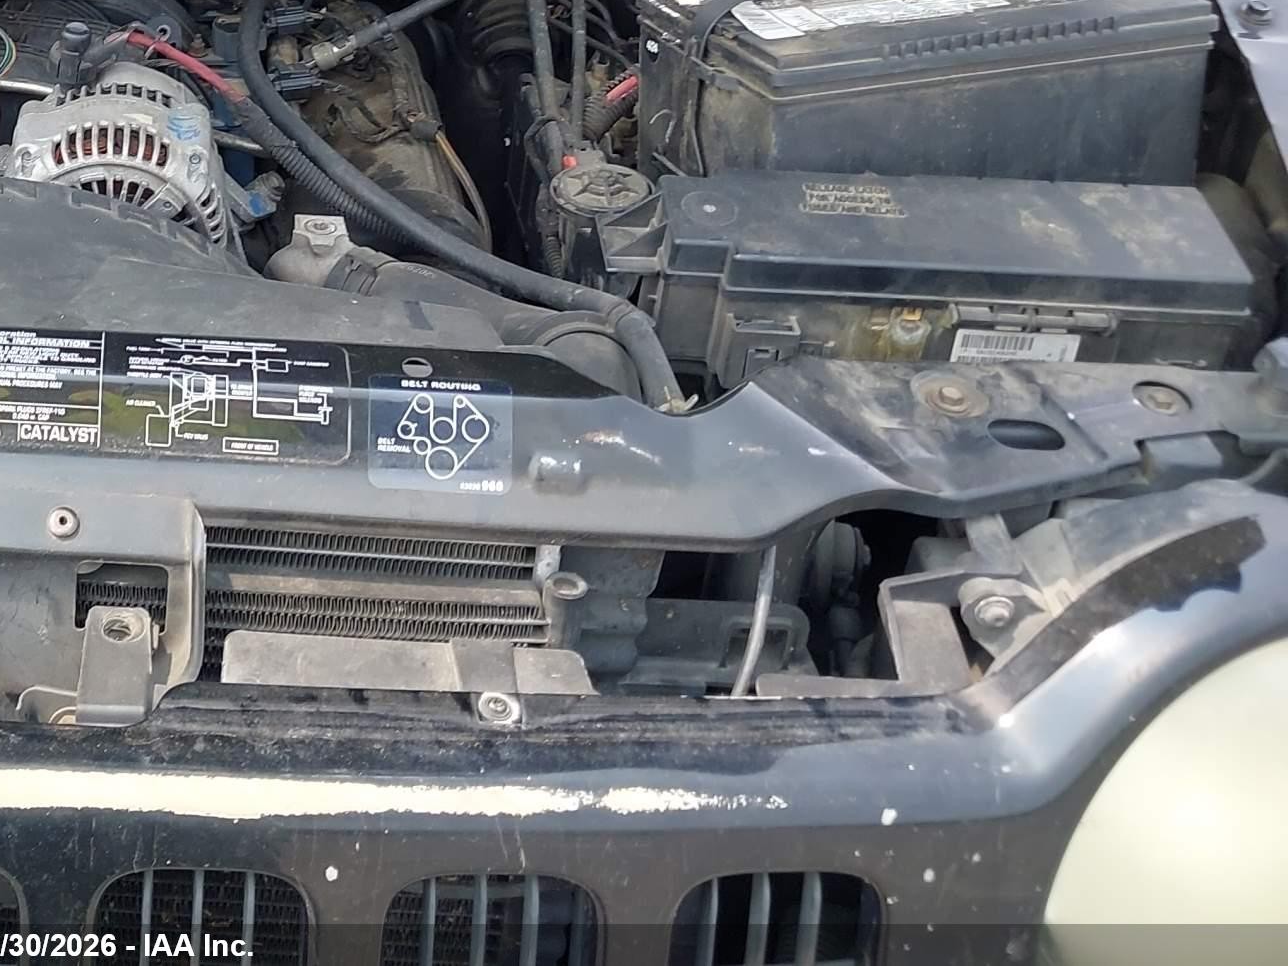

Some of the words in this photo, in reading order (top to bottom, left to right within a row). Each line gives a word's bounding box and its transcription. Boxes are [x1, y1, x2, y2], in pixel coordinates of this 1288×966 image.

[11, 336, 90, 348] INFORMATION
[401, 379, 429, 388] BELT
[431, 381, 482, 391] ROUTING
[21, 424, 98, 443] CATALYST
[377, 437, 396, 445] BELT
[377, 444, 412, 453] REMOVAL
